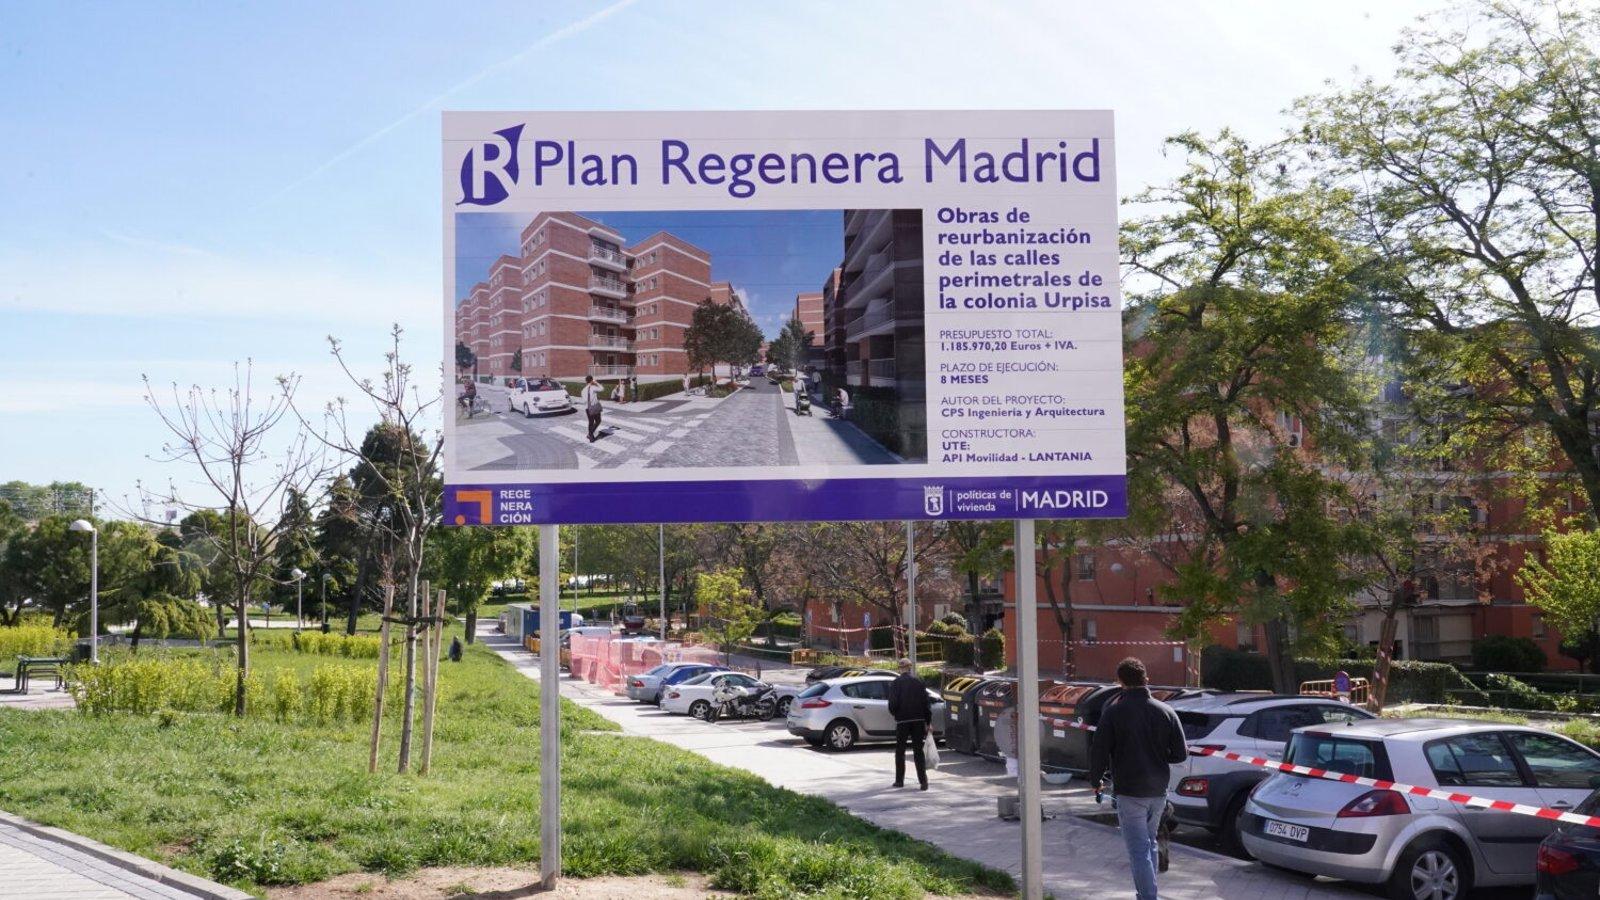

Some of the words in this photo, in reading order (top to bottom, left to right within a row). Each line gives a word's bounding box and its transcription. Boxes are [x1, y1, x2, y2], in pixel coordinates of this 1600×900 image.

[535, 140, 638, 186] Plan
[662, 139, 904, 198] Regenera
[925, 138, 1100, 183] Madrid
[937, 207, 999, 223] Obras
[1006, 207, 1030, 223] de
[938, 228, 1091, 244] reurbanización
[939, 251, 962, 266] de
[971, 250, 996, 266] las
[1004, 250, 1060, 265] calles
[939, 271, 1071, 291] perimetrales
[1078, 271, 1102, 286] de
[940, 293, 956, 309] la
[964, 293, 1037, 308] colonia
[1045, 292, 1111, 311] Urpisa
[940, 330, 1012, 339] PRESUPUESTO
[1016, 330, 1053, 338] TOTAL:
[941, 342, 1007, 352] 1.185.970,20
[1011, 342, 1041, 351] Euros
[1055, 341, 1078, 350] IVA.
[940, 363, 975, 372] PLAZO
[979, 363, 993, 372] DE
[996, 361, 1058, 374] EJECUCIÓN:
[941, 375, 947, 384] 8
[951, 375, 988, 383] MESES
[941, 396, 979, 405] AUTOR
[983, 396, 1002, 404] DEL
[1006, 395, 1065, 404] PROYECTO:
[942, 408, 964, 417] CPS
[1026, 410, 1031, 418] y
[1035, 407, 1105, 418] Arquitectura
[942, 429, 1036, 438] CONSTRUCTORA:
[942, 442, 970, 450] UTE:
[943, 454, 962, 462] API
[967, 453, 1018, 462] Movilidad
[1029, 452, 1092, 461] LANTANIA
[501, 490, 530, 499] REGE
[957, 490, 996, 502] políticas
[1000, 490, 1011, 499] de
[1022, 491, 1109, 509] MADRID
[501, 502, 532, 511] NERA
[501, 513, 531, 523] CIÓN
[1290, 826, 1308, 839] DVP
